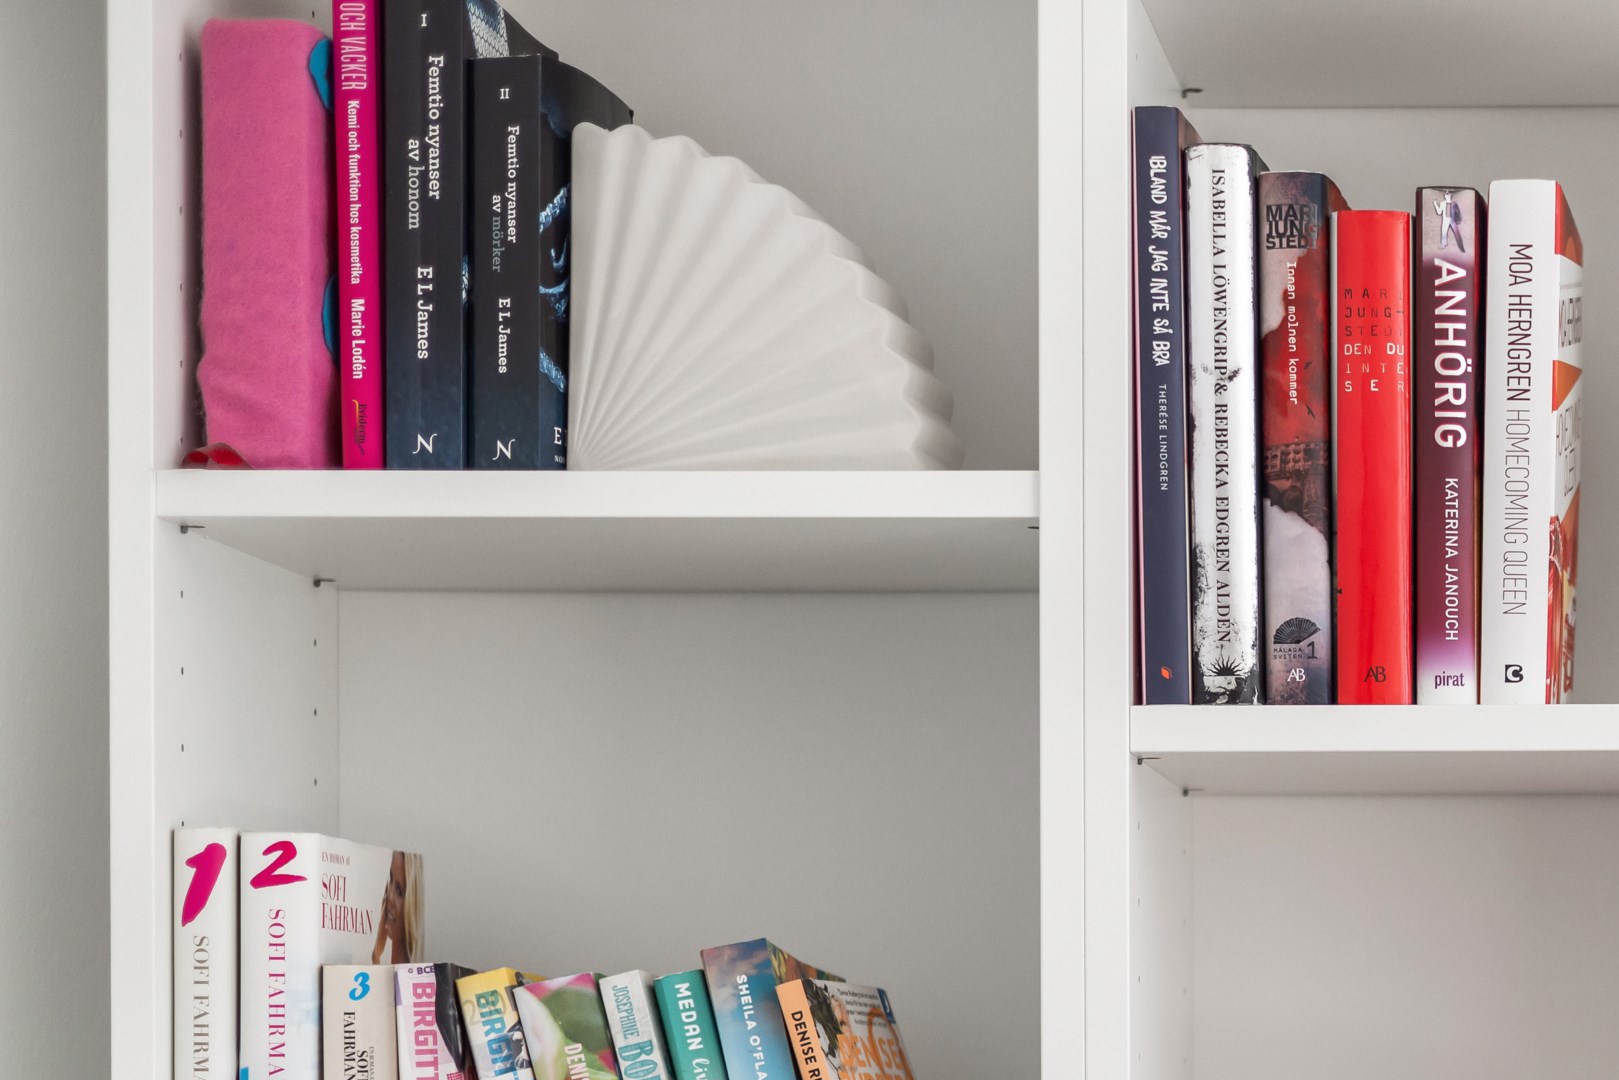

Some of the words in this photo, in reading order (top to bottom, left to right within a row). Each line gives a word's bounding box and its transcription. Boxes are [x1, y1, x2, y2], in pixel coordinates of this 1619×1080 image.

[340, 3, 366, 31] OCH
[341, 36, 367, 90] VACKER
[429, 55, 444, 120] Femtio
[348, 100, 360, 128] Kemi
[348, 131, 360, 151] och
[408, 139, 419, 162] av
[427, 125, 440, 199] nyanser
[507, 125, 520, 178] Femtio
[349, 153, 361, 202] funktion
[408, 166, 425, 229] honom
[1150, 156, 1167, 205] IBLAND
[350, 205, 361, 224] hos
[506, 181, 517, 243] nyanser
[1150, 211, 1171, 240] MÅR
[350, 227, 361, 284] kosmetika
[1148, 246, 1168, 272] JAG
[1509, 244, 1533, 286] MOA
[1150, 278, 1170, 312] INTE
[1286, 262, 1296, 299] Innan
[351, 298, 363, 337] Marie
[1152, 318, 1173, 335] SÅ
[1287, 306, 1298, 352] molnen
[352, 339, 364, 379] Lodén
[1152, 341, 1171, 366] BRA
[1344, 344, 1371, 355] DEN
[1387, 343, 1404, 355] DU
[1346, 363, 1404, 374] INTE
[1434, 258, 1472, 448] ANHÖRIG
[1507, 295, 1532, 401] HERNGREN
[1288, 358, 1299, 405] kommer
[1344, 380, 1404, 392] SER
[1157, 384, 1170, 430] THERÉSE
[1158, 435, 1169, 491] LINDGREN
[1504, 410, 1531, 544] HOMECOMING
[1445, 478, 1458, 559] KATERINA
[1445, 564, 1458, 640] JANOUCH
[1502, 551, 1528, 615] QUEEN
[1435, 671, 1465, 689] pirat
[268, 909, 286, 961] SOFI
[193, 935, 209, 985] SOFI
[612, 984, 640, 1039] JOSEPHINE
[791, 1010, 817, 1066] DENISE
